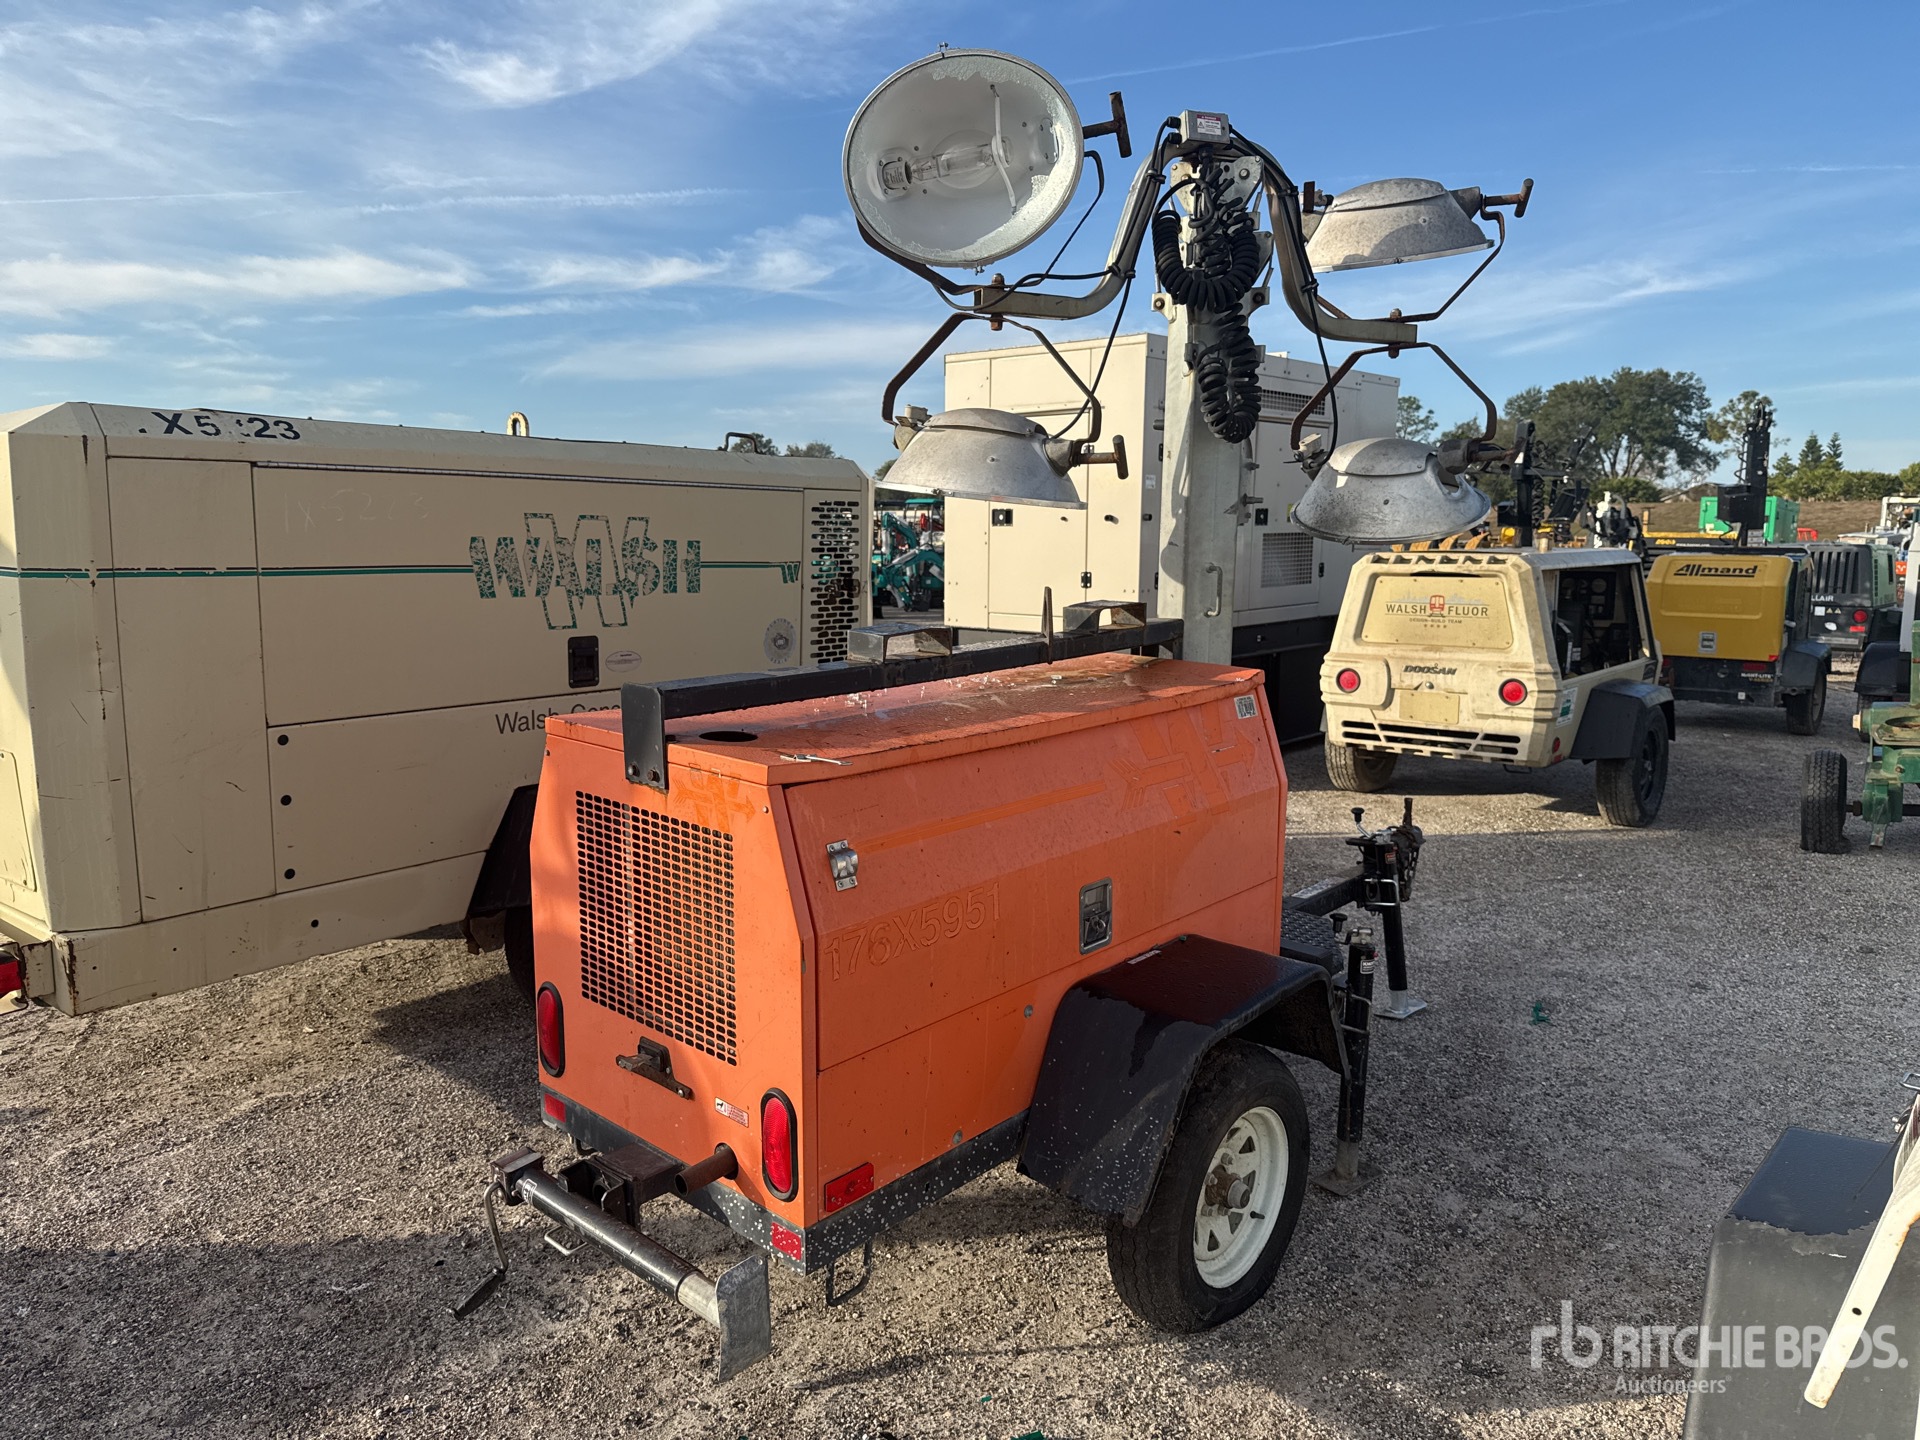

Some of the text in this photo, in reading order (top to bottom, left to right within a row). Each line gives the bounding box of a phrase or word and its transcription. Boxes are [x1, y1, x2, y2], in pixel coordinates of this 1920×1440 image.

[1673, 563, 1759, 578] Allmand
[1386, 604, 1489, 616] WALSH FLUOR
[1404, 664, 1457, 675] DOOSAN
[824, 882, 1000, 982] 176X5951
